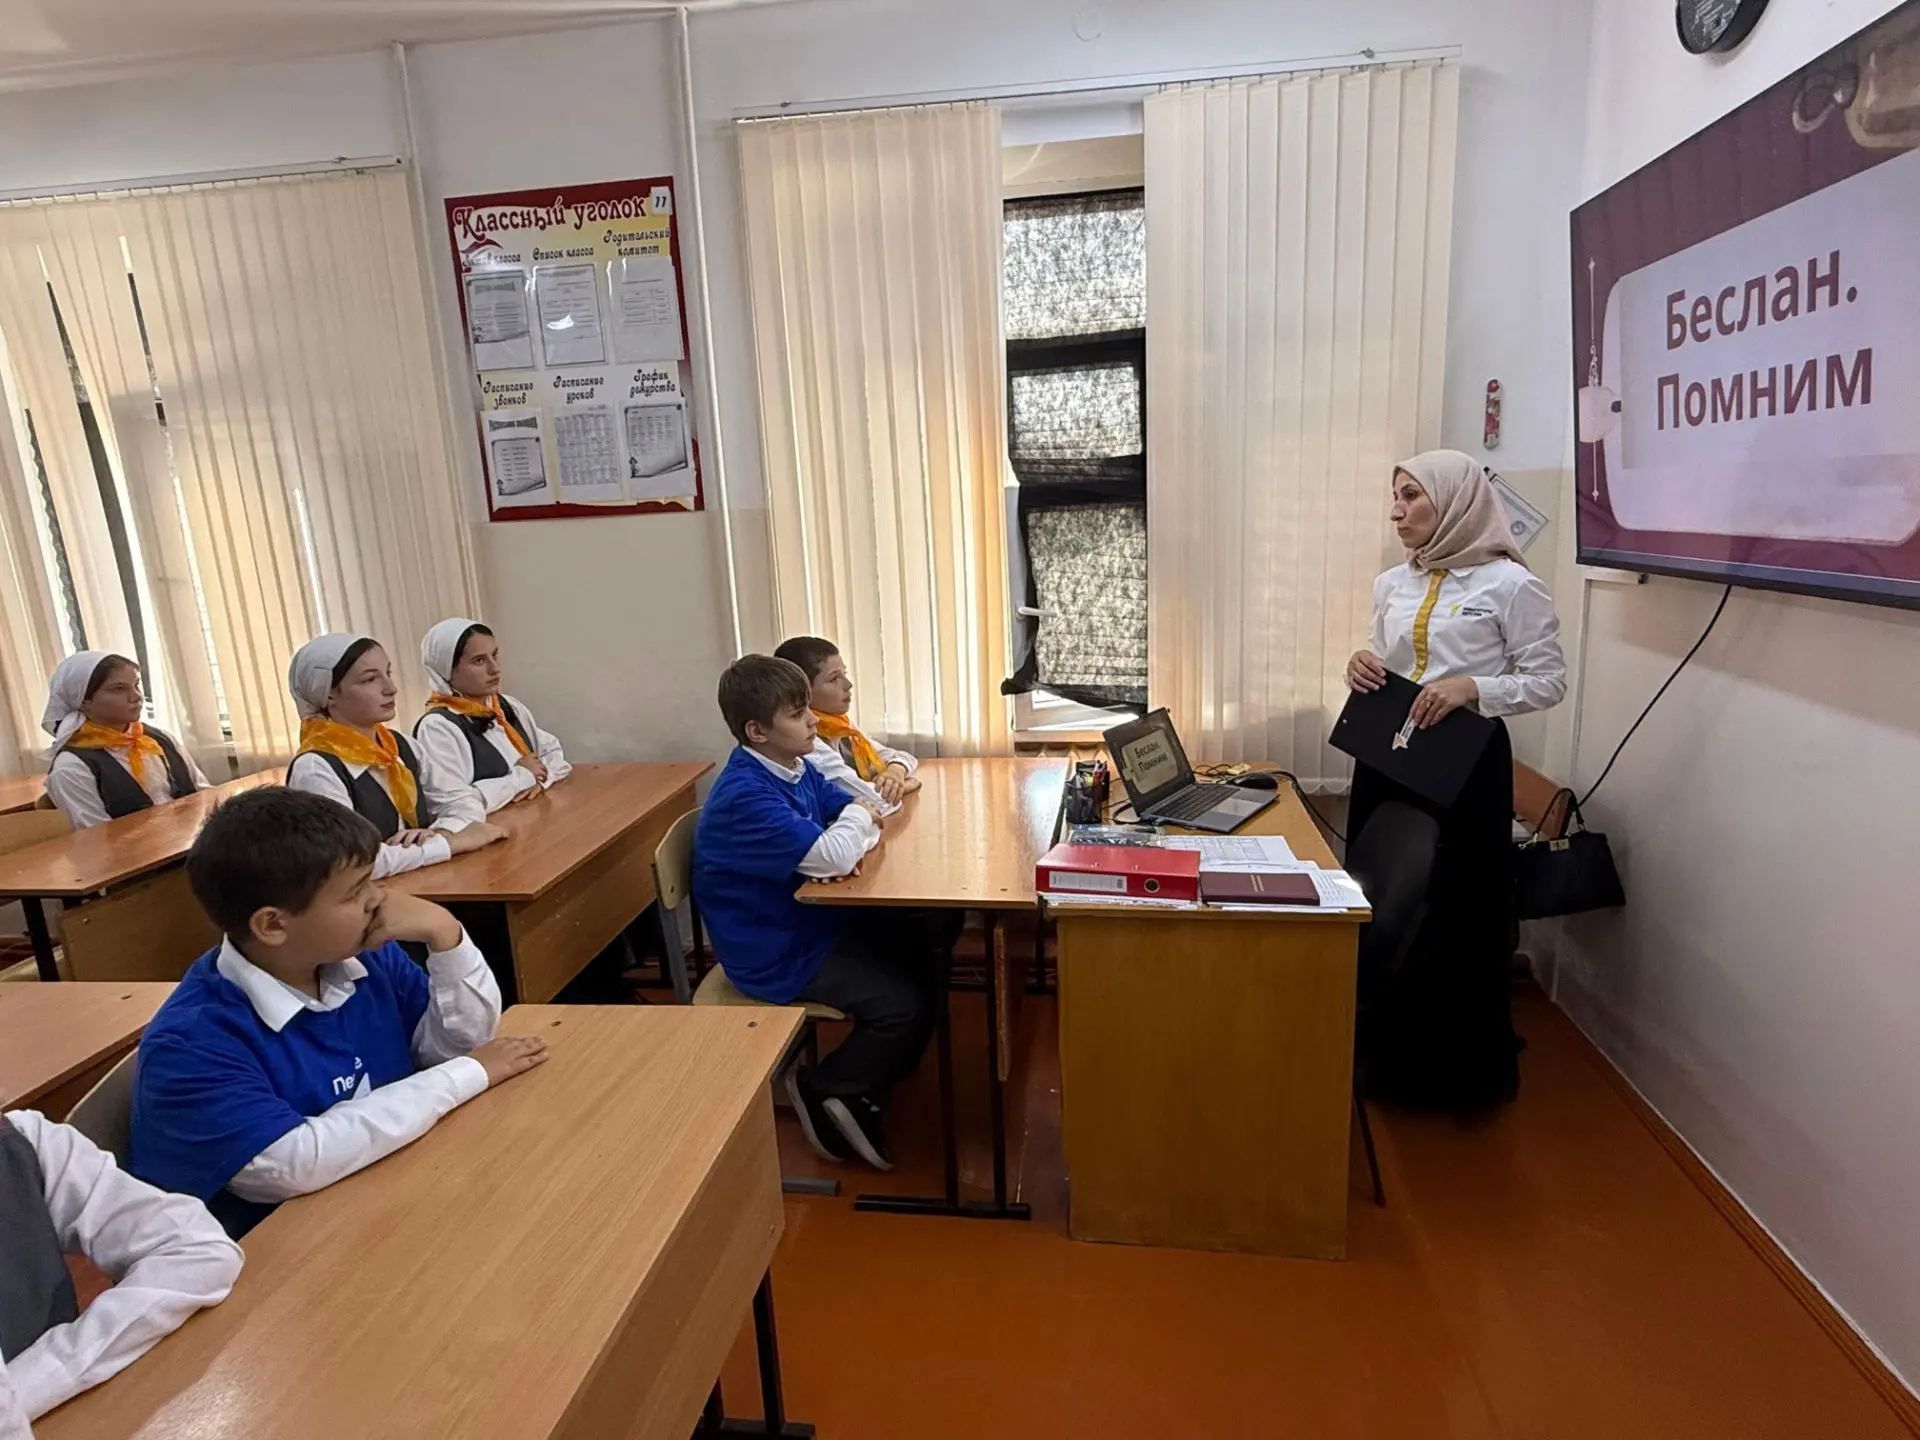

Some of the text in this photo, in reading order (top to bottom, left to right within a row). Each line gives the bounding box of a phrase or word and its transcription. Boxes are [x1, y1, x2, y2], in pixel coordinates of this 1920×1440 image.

[655, 195, 667, 208] 11
[454, 196, 647, 242] Классный уголок
[533, 246, 594, 260] Список класса
[1666, 250, 1858, 350] Беслан.
[553, 375, 604, 389] Расписание
[634, 369, 669, 384] График
[483, 381, 534, 394] Расписание
[630, 380, 676, 399] дежурства
[1656, 347, 1873, 431] Помним
[493, 392, 527, 410] звонков
[566, 388, 595, 405] уроков
